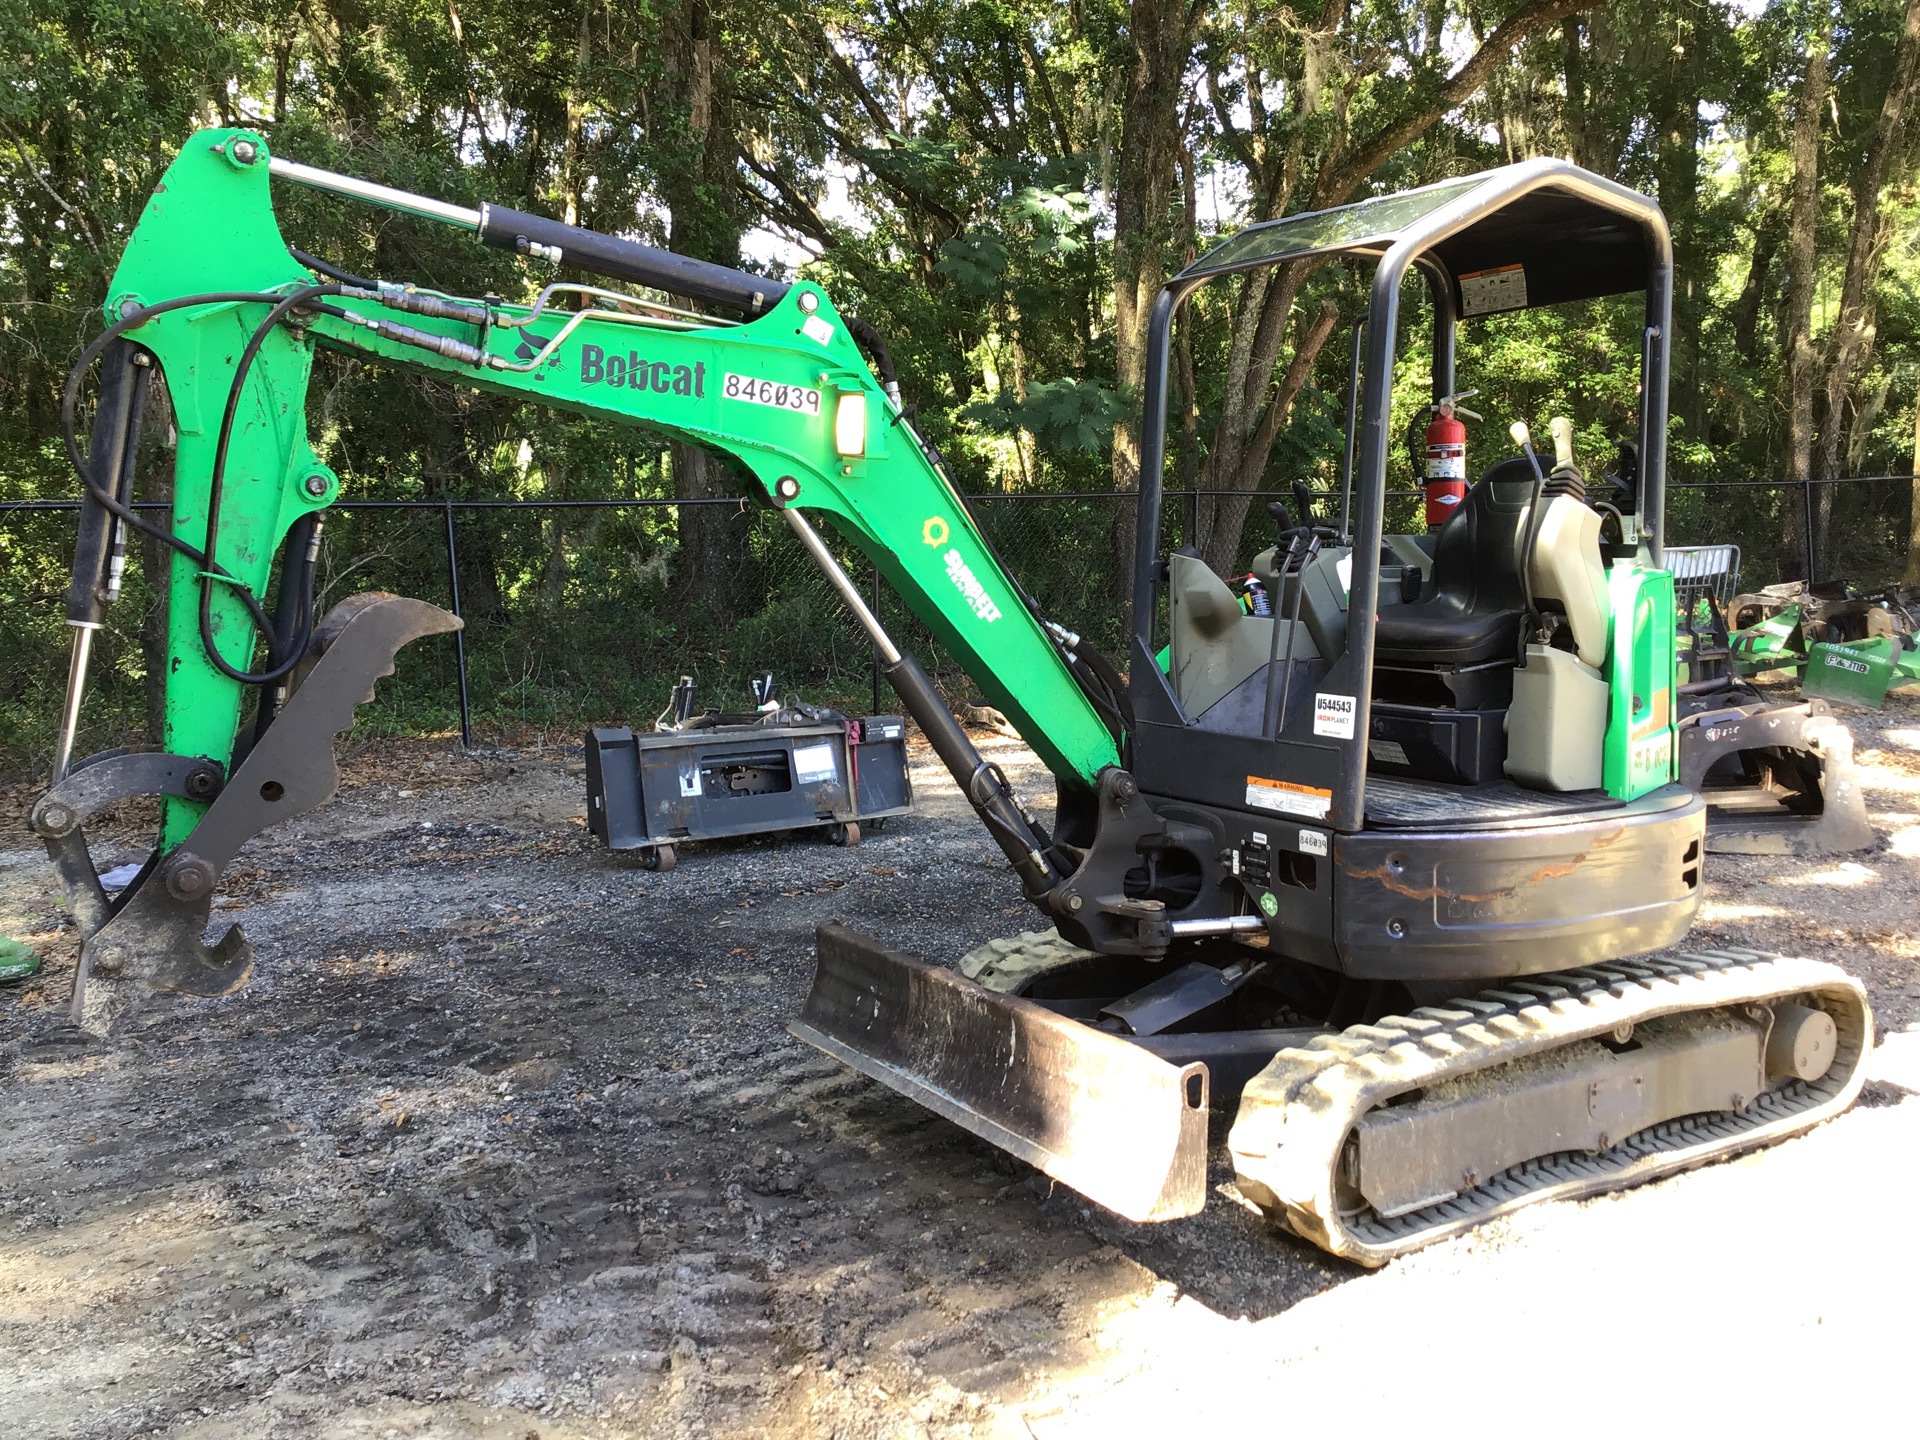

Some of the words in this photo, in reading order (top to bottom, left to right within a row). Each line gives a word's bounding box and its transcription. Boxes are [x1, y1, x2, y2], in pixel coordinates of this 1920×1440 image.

[581, 343, 706, 399] Bobcat
[725, 374, 820, 413] 846039
[1317, 698, 1352, 713] U544543
[1316, 714, 1349, 725] IRONPLANET
[1278, 783, 1304, 793] WARNING
[1299, 835, 1327, 849] 846039
